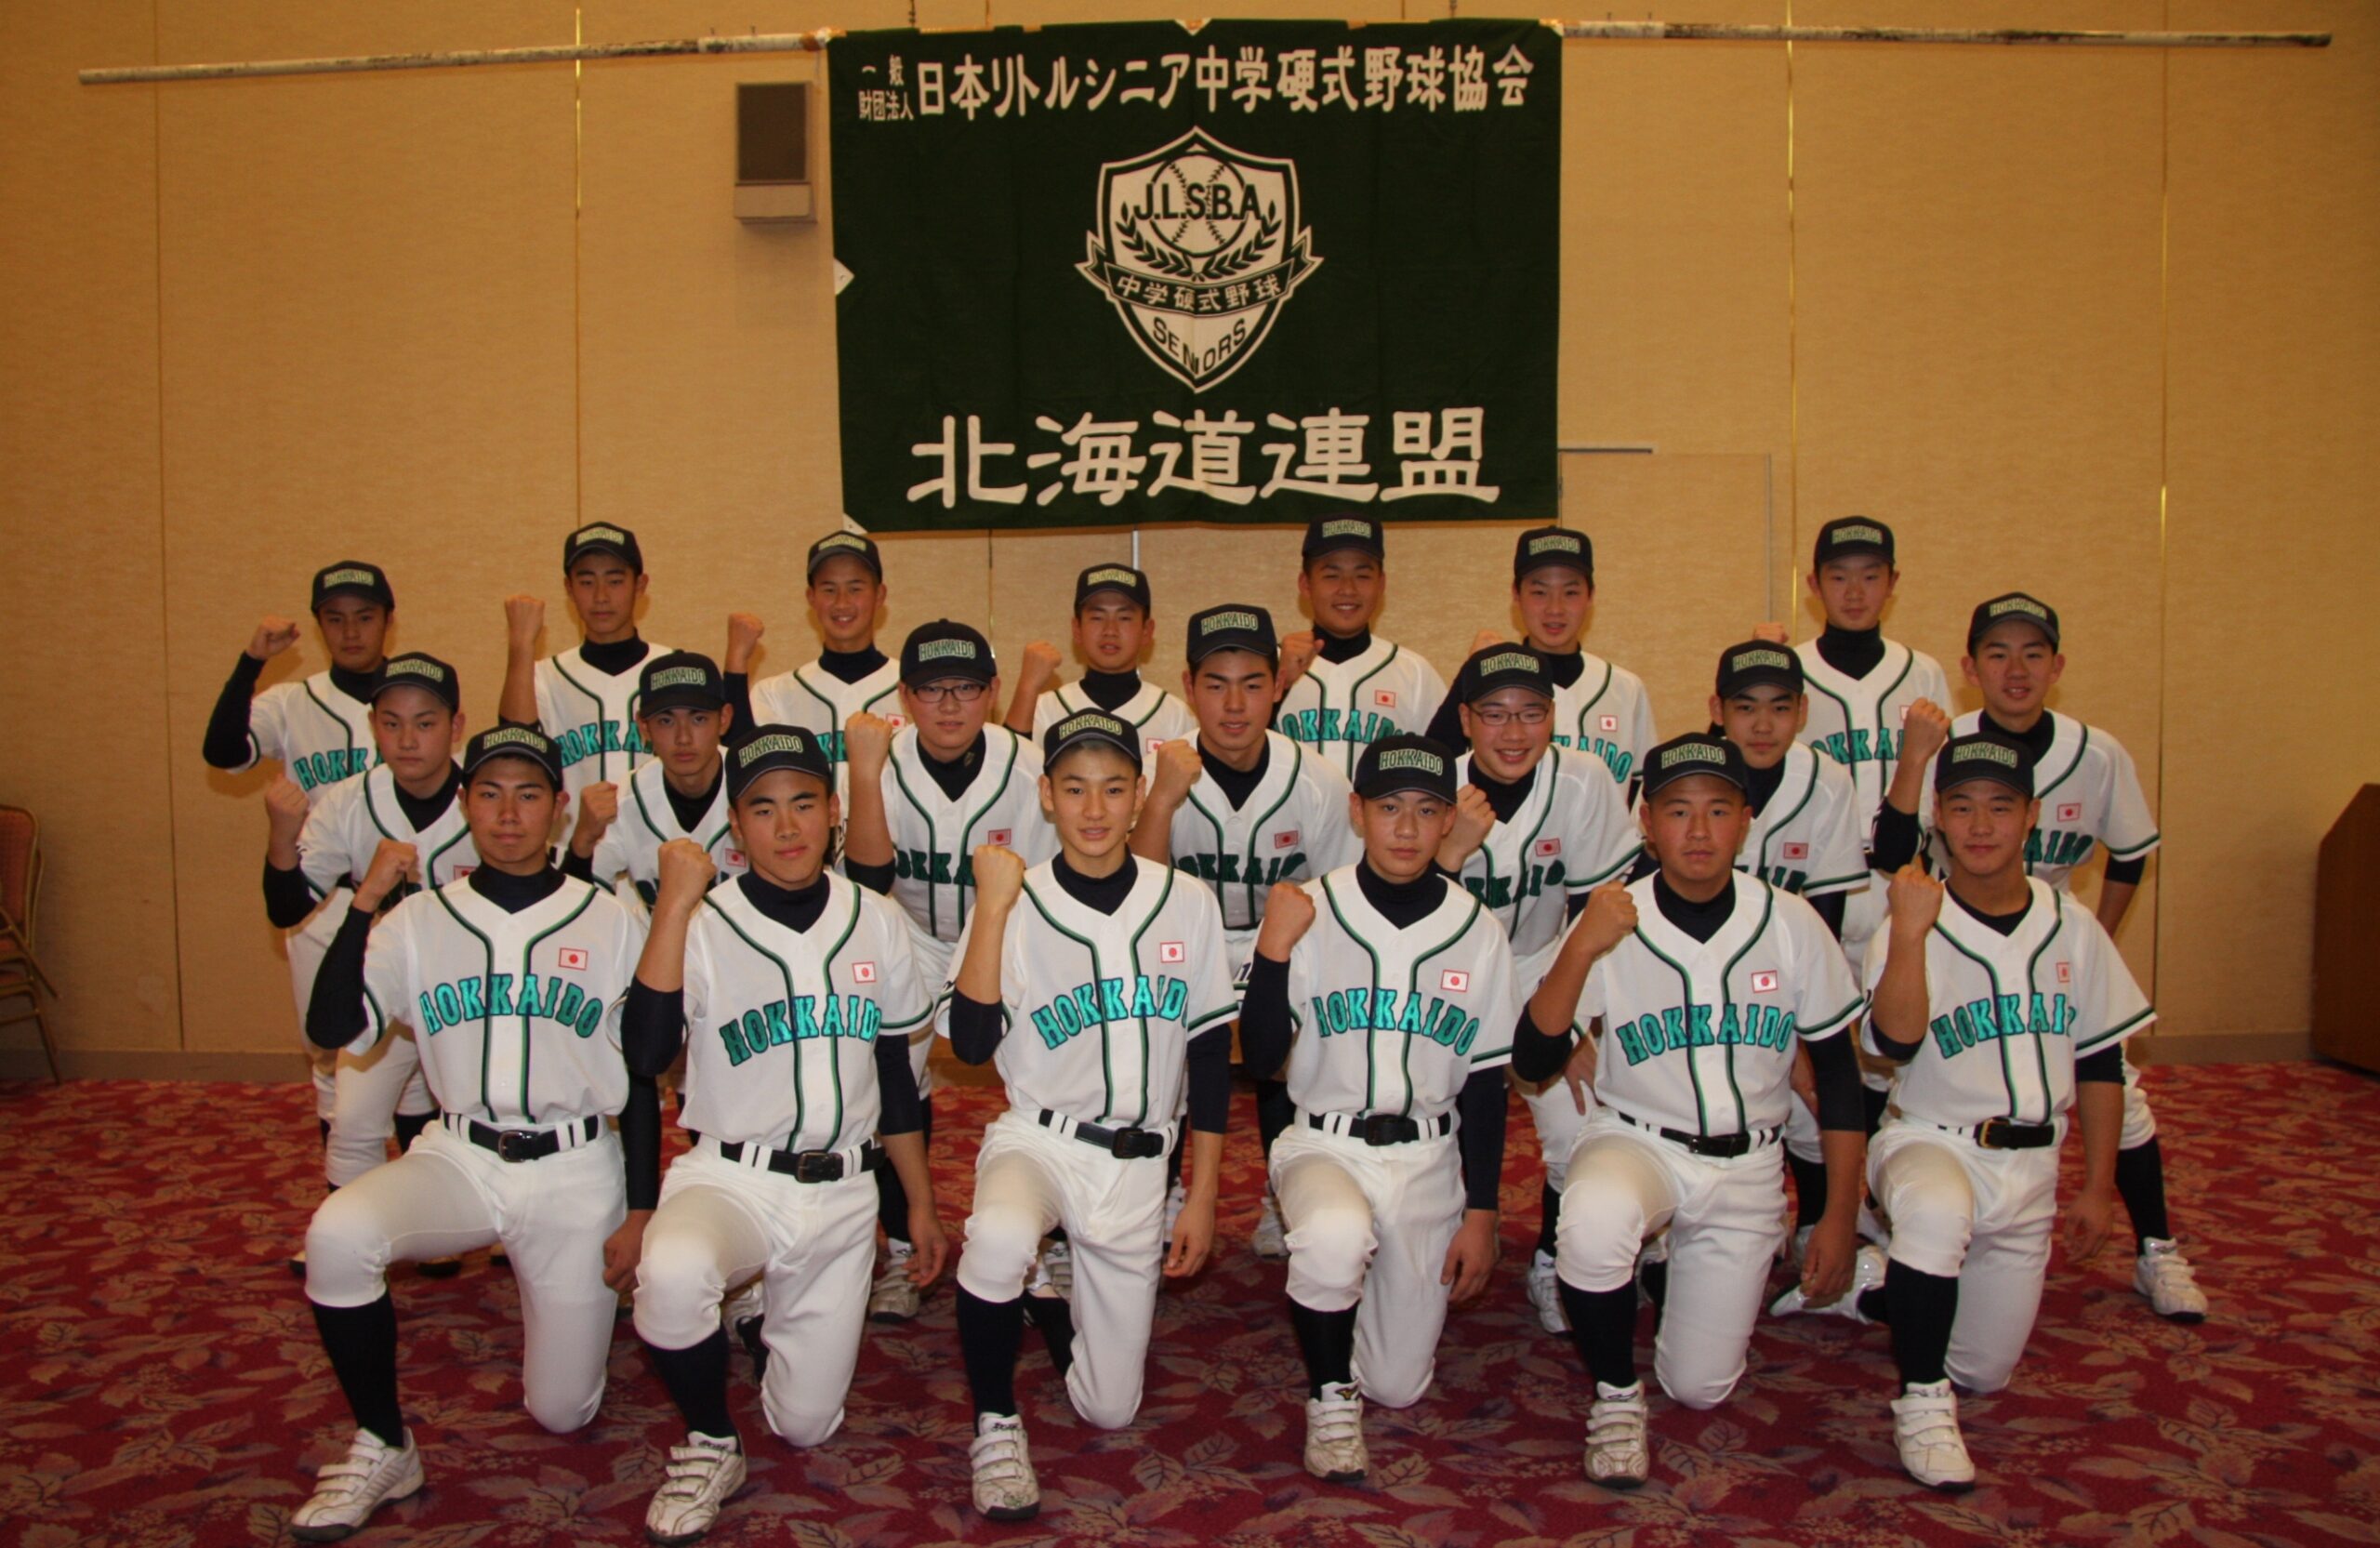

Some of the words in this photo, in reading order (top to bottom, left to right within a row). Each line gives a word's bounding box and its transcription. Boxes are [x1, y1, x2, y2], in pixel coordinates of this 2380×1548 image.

[918, 44, 1534, 121] 日本リトルシニア中学硬式野球協会
[858, 90, 915, 122] 財団法人
[1117, 274, 1282, 312] 中学硬式野球
[1153, 317, 1247, 375] SENIORS
[907, 408, 1501, 509] 北海道連盟
[1322, 519, 1372, 539] HOKKAIDO
[1528, 535, 1580, 556] HOKKAIDO
[1200, 612, 1259, 636] HOKKAIDO
[919, 639, 976, 662] HOKKAIDO
[1732, 649, 1791, 672] HOKKAIDO
[1481, 653, 1540, 677] HOKKAIDO
[651, 667, 707, 691] HOKKAIDO
[1059, 714, 1123, 740] HOKKAIDO
[483, 729, 548, 754] HOKKAIDO
[739, 734, 803, 768] HOKKAIDO
[1380, 748, 1444, 775] HOKKAIDO
[1661, 742, 1726, 770] HOKKAIDO
[1952, 742, 2018, 769] HOKKAIDO
[419, 973, 603, 1039] HOKKAIDO
[1312, 987, 1479, 1056] HOKKAIDO
[1615, 1003, 1795, 1066] HOKKAIDO
[1930, 992, 2076, 1060] HOKKAI
